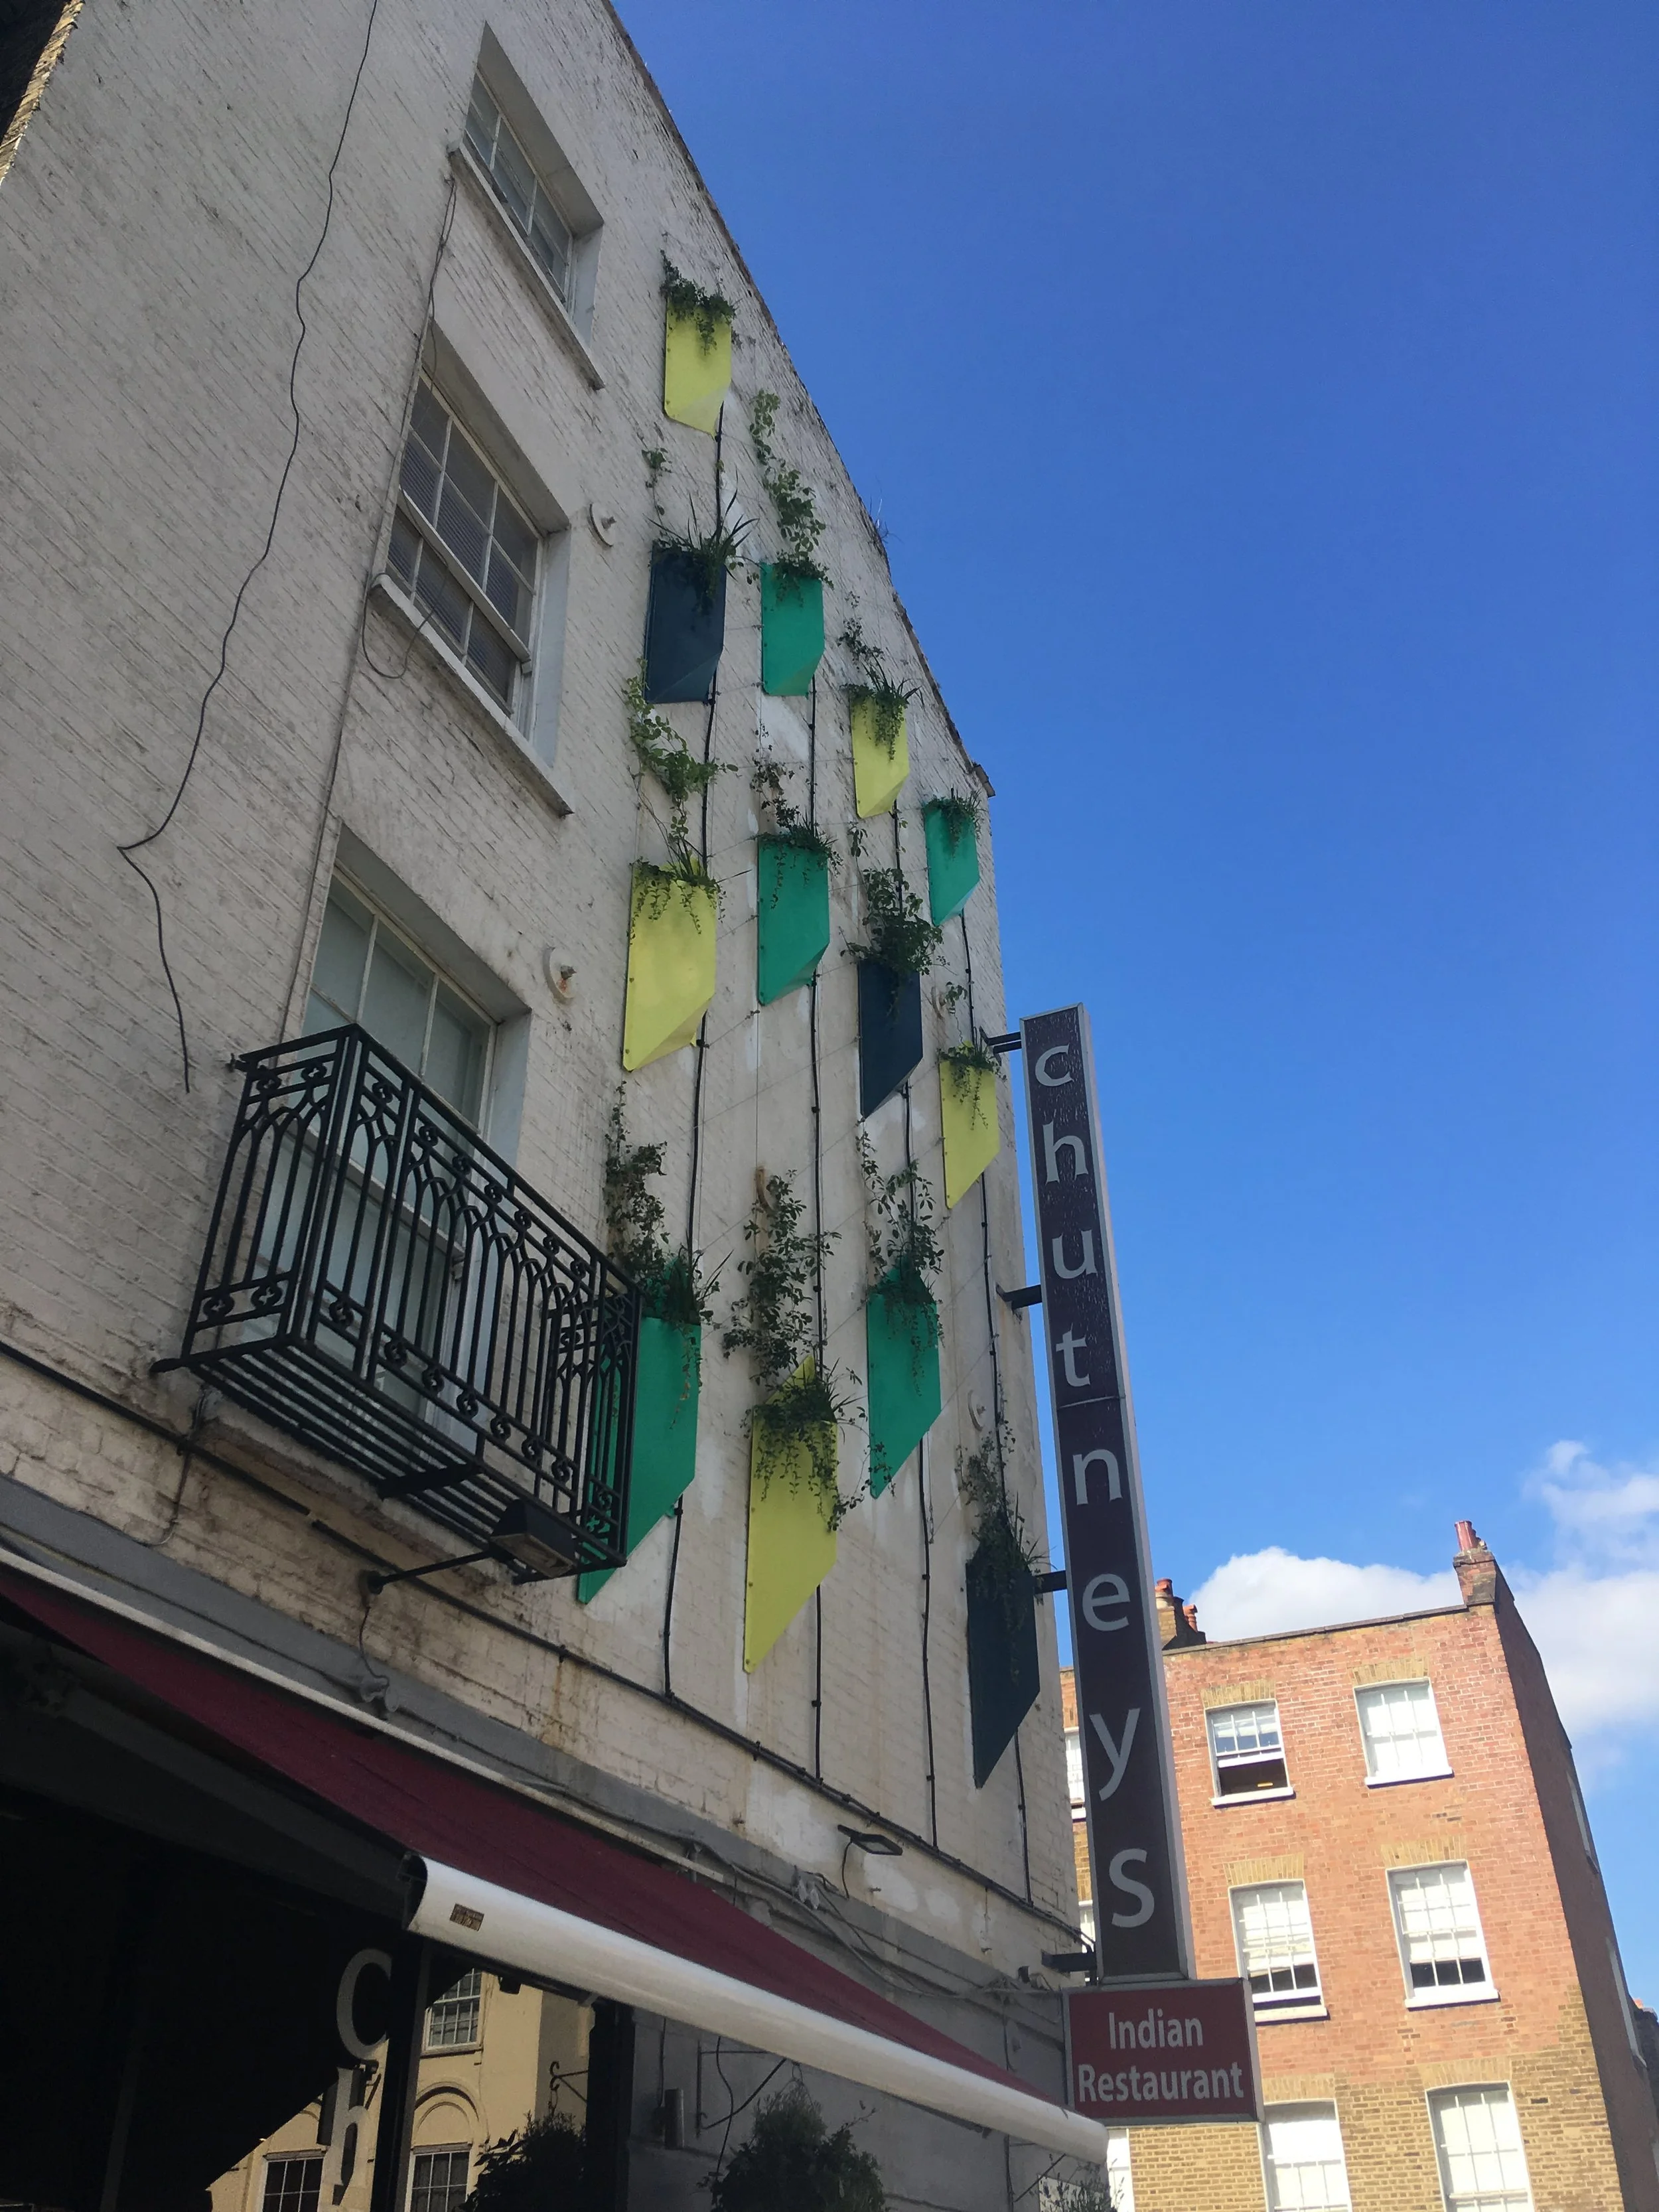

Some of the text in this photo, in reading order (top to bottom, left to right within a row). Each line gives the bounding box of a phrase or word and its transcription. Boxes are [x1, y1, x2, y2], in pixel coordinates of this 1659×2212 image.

[1035, 1043, 1155, 1929] chutneys
[1109, 2008, 1204, 2049] Indian
[1078, 2061, 1244, 2102] Restaurant
